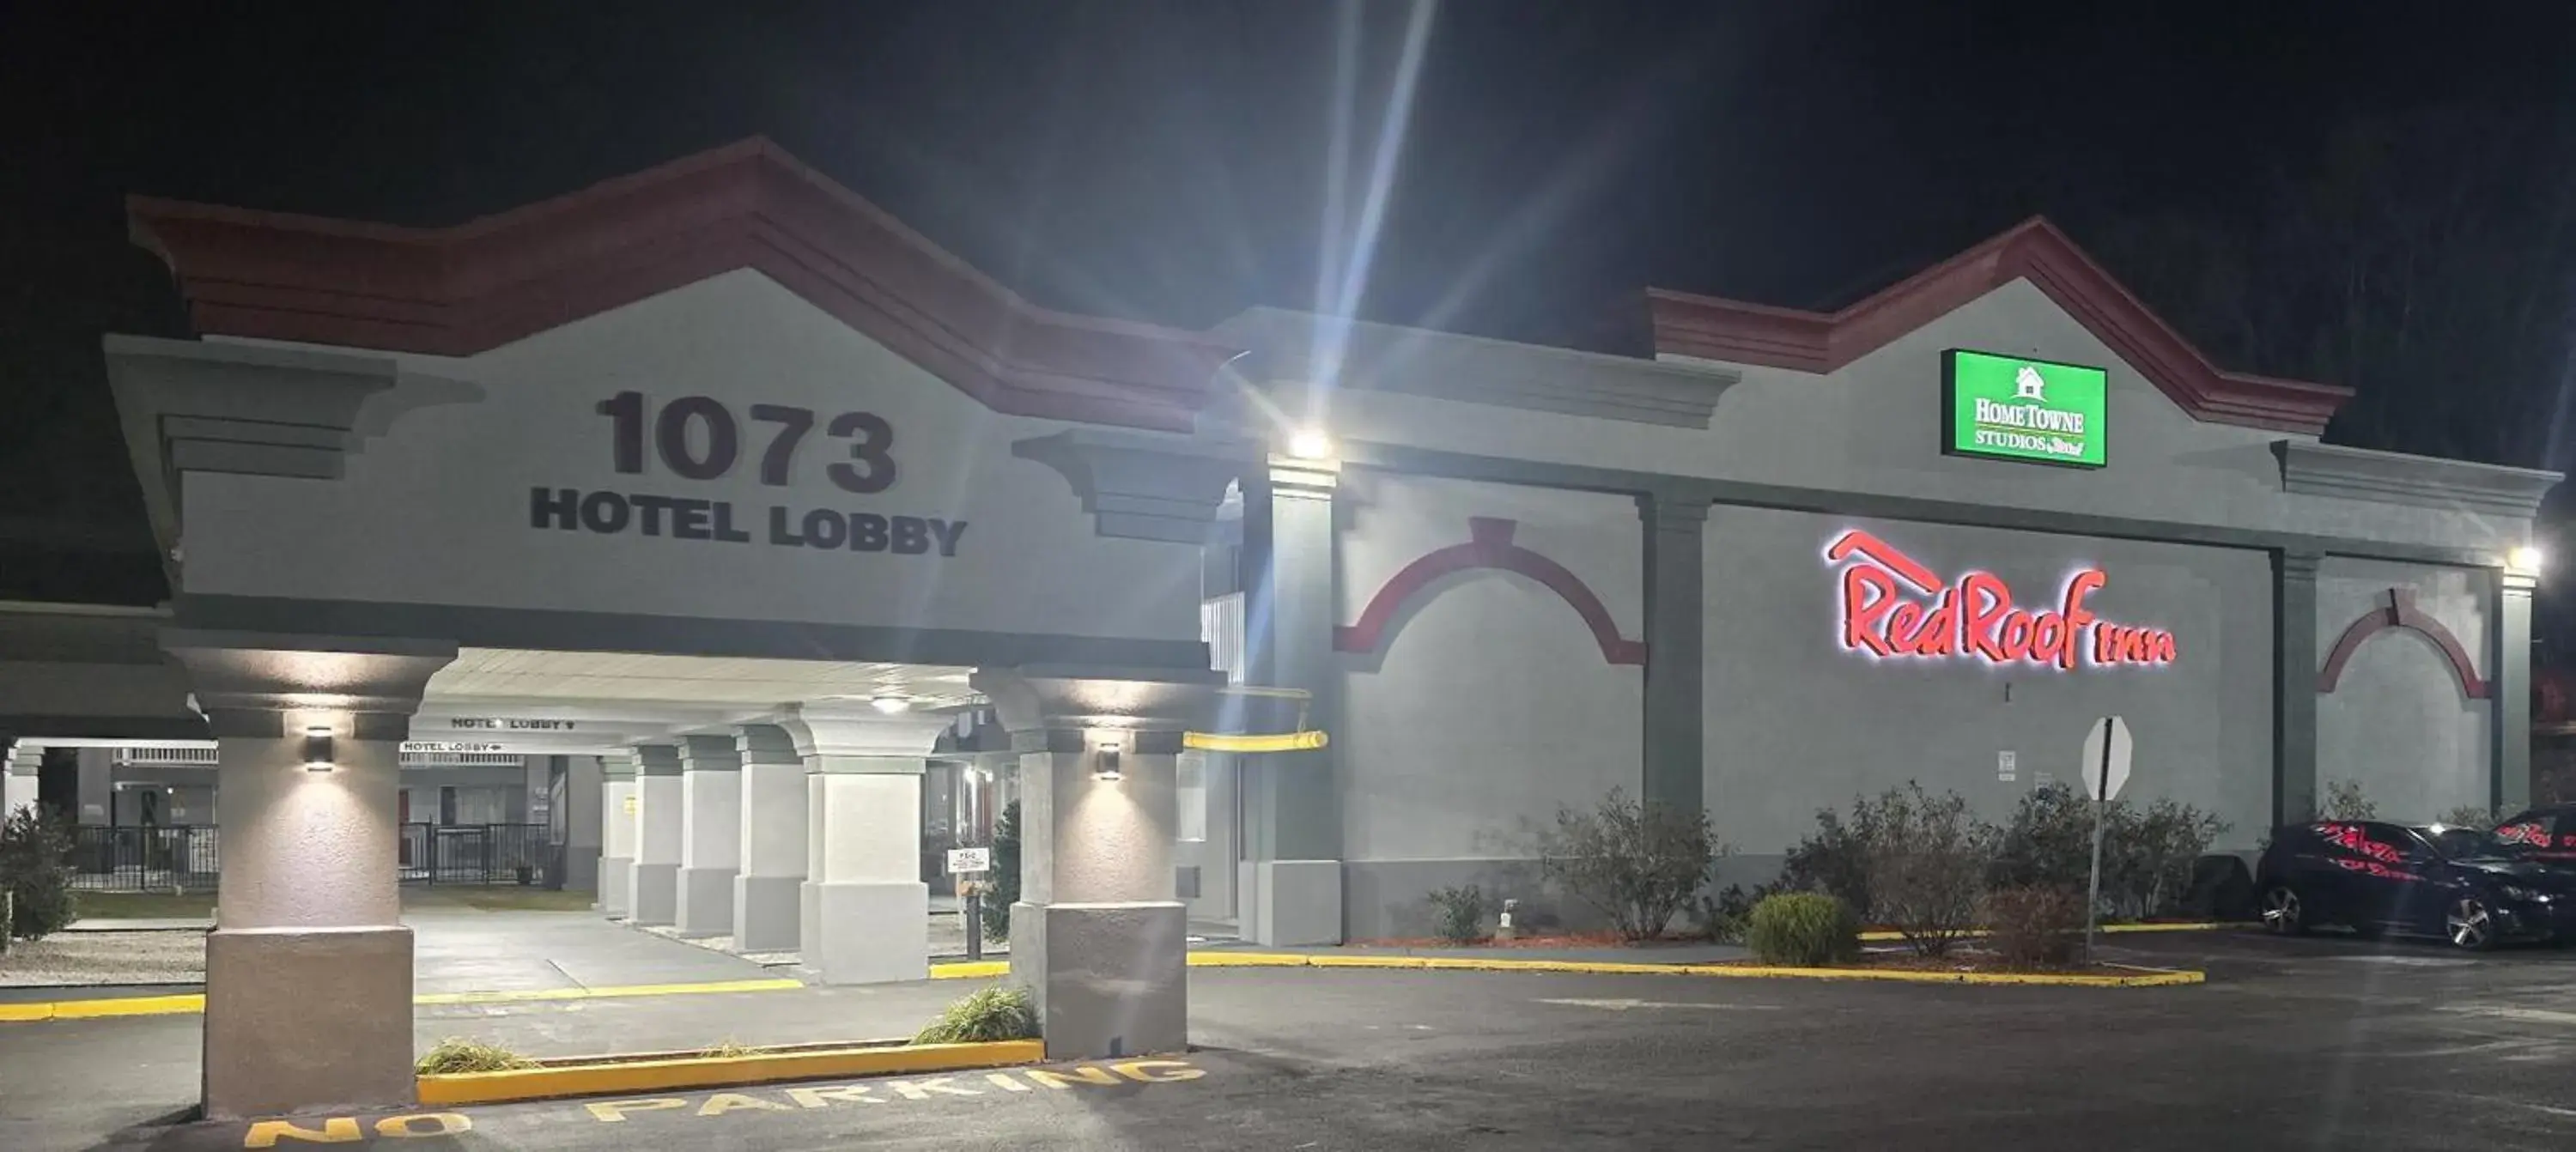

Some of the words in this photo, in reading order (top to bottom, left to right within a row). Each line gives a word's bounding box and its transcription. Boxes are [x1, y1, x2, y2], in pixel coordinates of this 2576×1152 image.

[595, 391, 899, 494] 1073
[1976, 431, 2046, 451] STUDIOS
[530, 487, 750, 543] HOTEL
[769, 506, 968, 556] LOBBY
[451, 718, 503, 729] HOTE
[509, 719, 561, 730] LOBBY
[244, 1113, 472, 1148] NO
[583, 1058, 1209, 1122] PARKING
